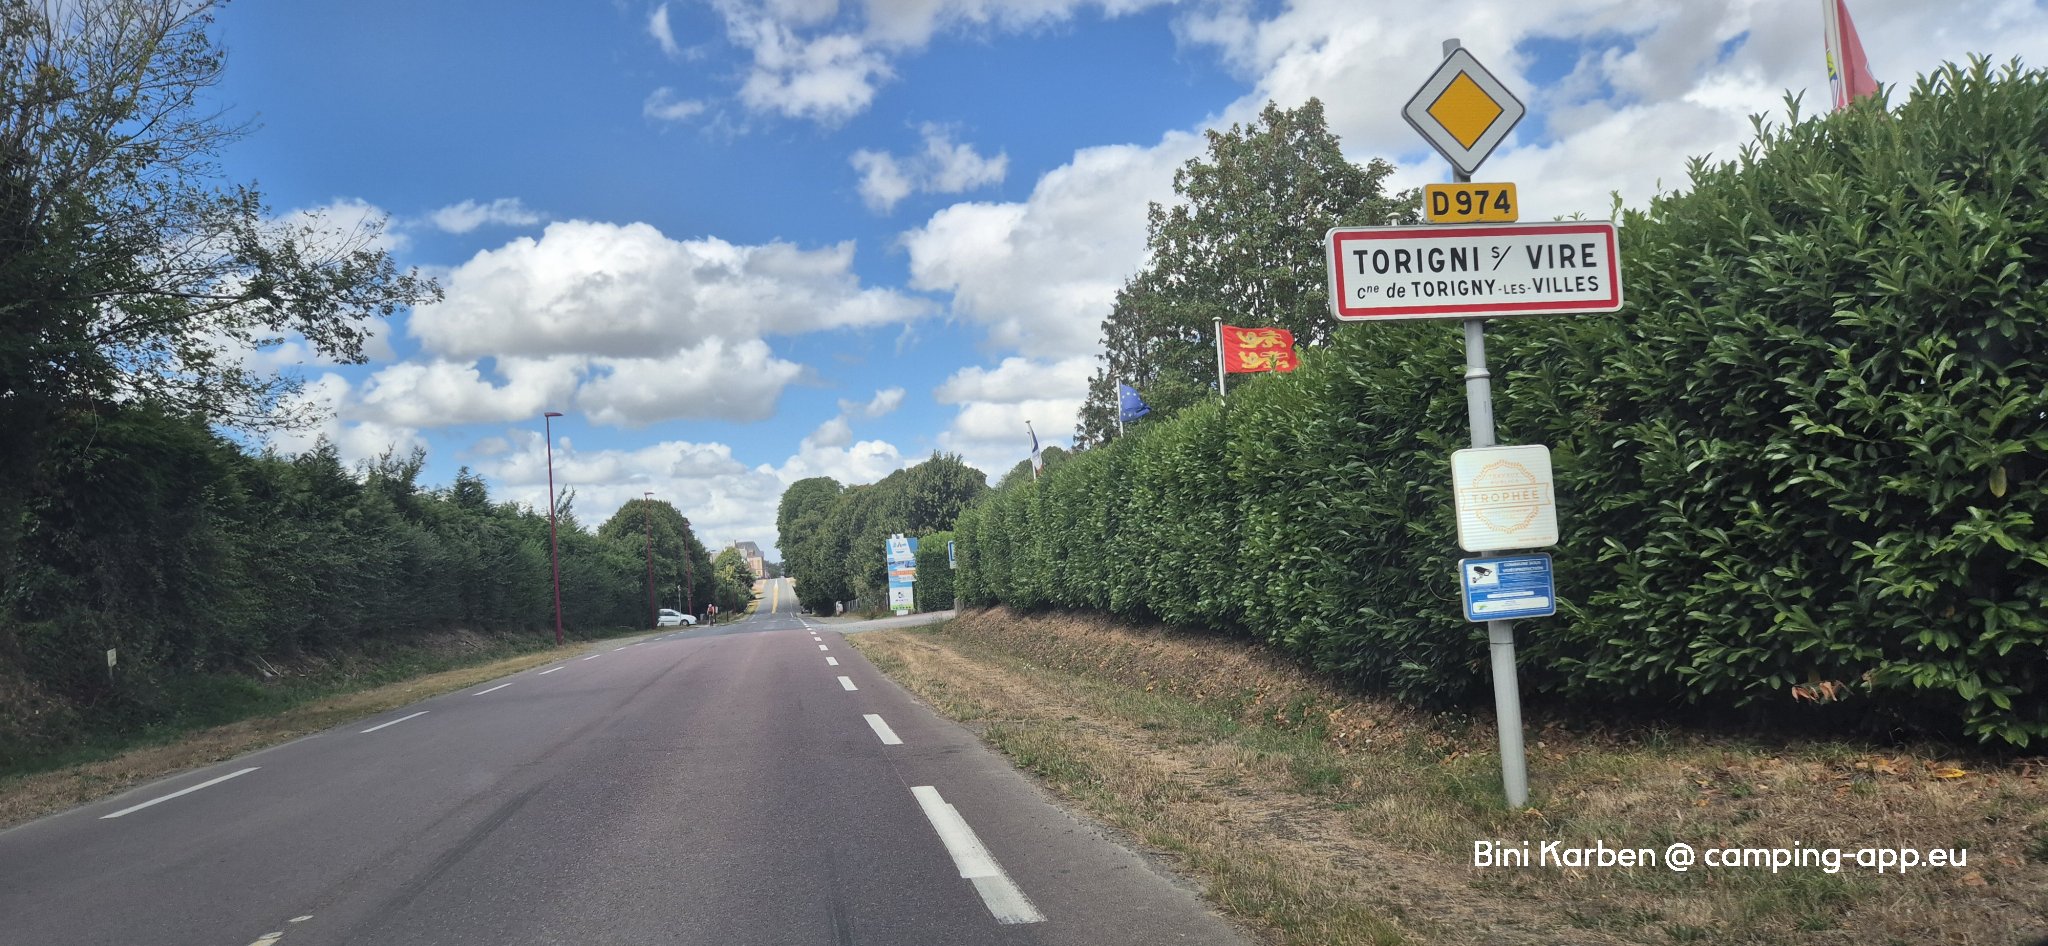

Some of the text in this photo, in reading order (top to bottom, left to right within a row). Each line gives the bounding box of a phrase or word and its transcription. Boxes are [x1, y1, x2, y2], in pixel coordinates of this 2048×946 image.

[1353, 246, 1479, 275] TORIGNI
[1526, 242, 1597, 270] VIRE
[1386, 282, 1406, 299] de
